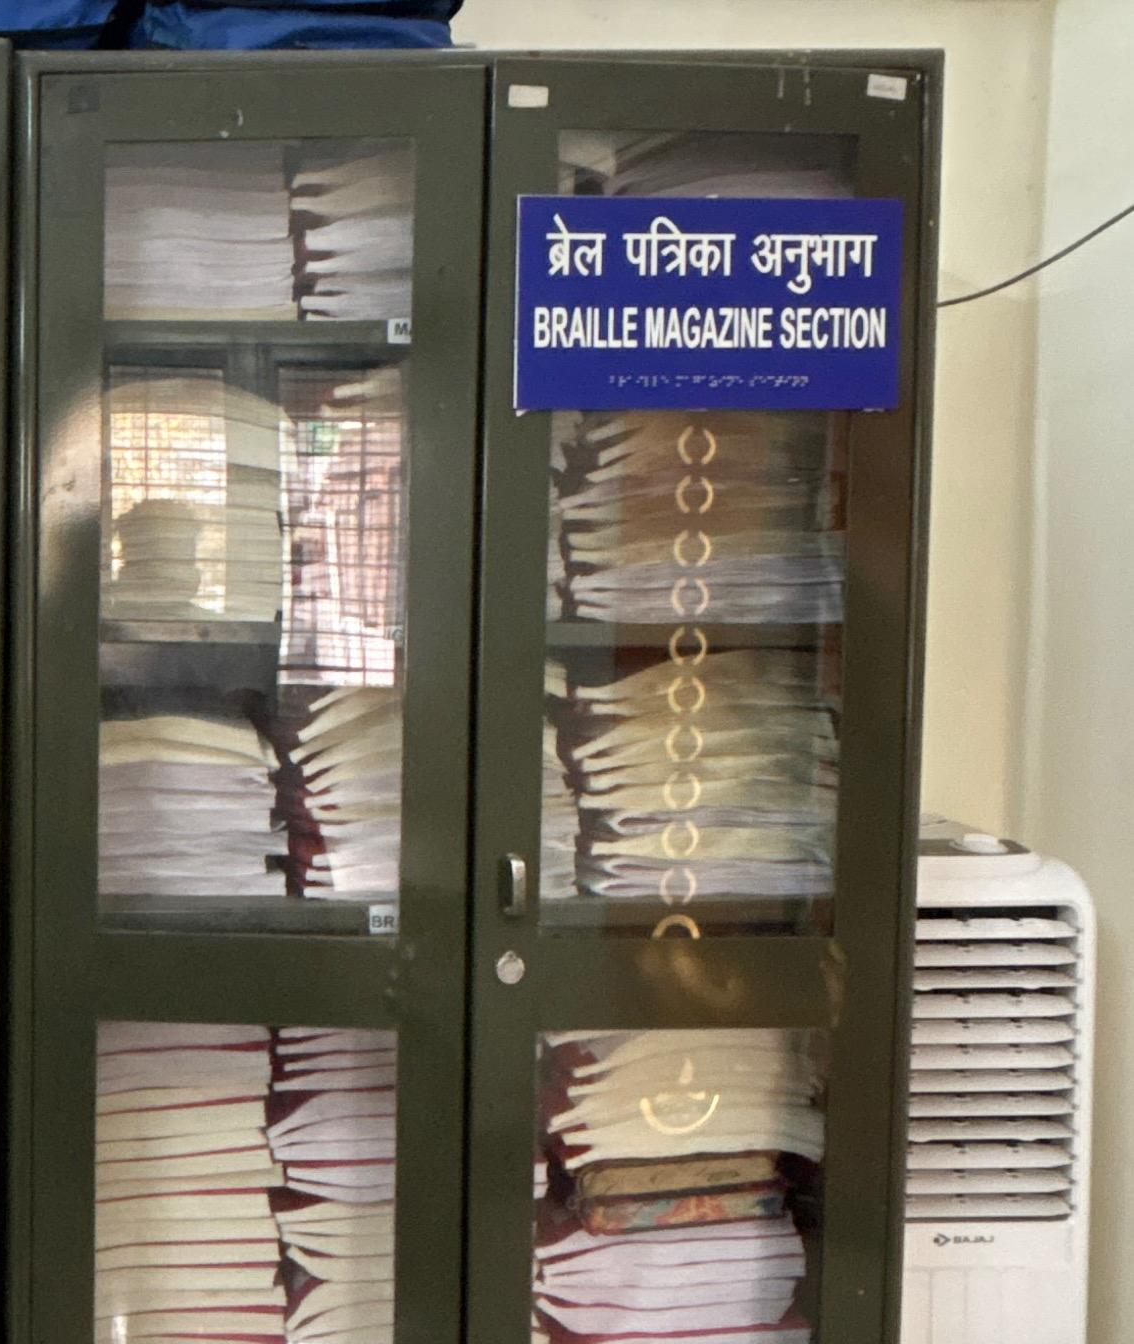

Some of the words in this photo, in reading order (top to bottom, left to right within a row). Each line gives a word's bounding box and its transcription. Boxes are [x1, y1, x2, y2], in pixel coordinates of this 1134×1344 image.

[546, 214, 606, 276] ब्रेल
[623, 217, 736, 276] पत्रिका
[751, 234, 877, 294] अनुभाग
[534, 307, 638, 348] BRAILLE
[645, 307, 773, 348] MAGAZINE
[780, 307, 886, 348] SECTION
